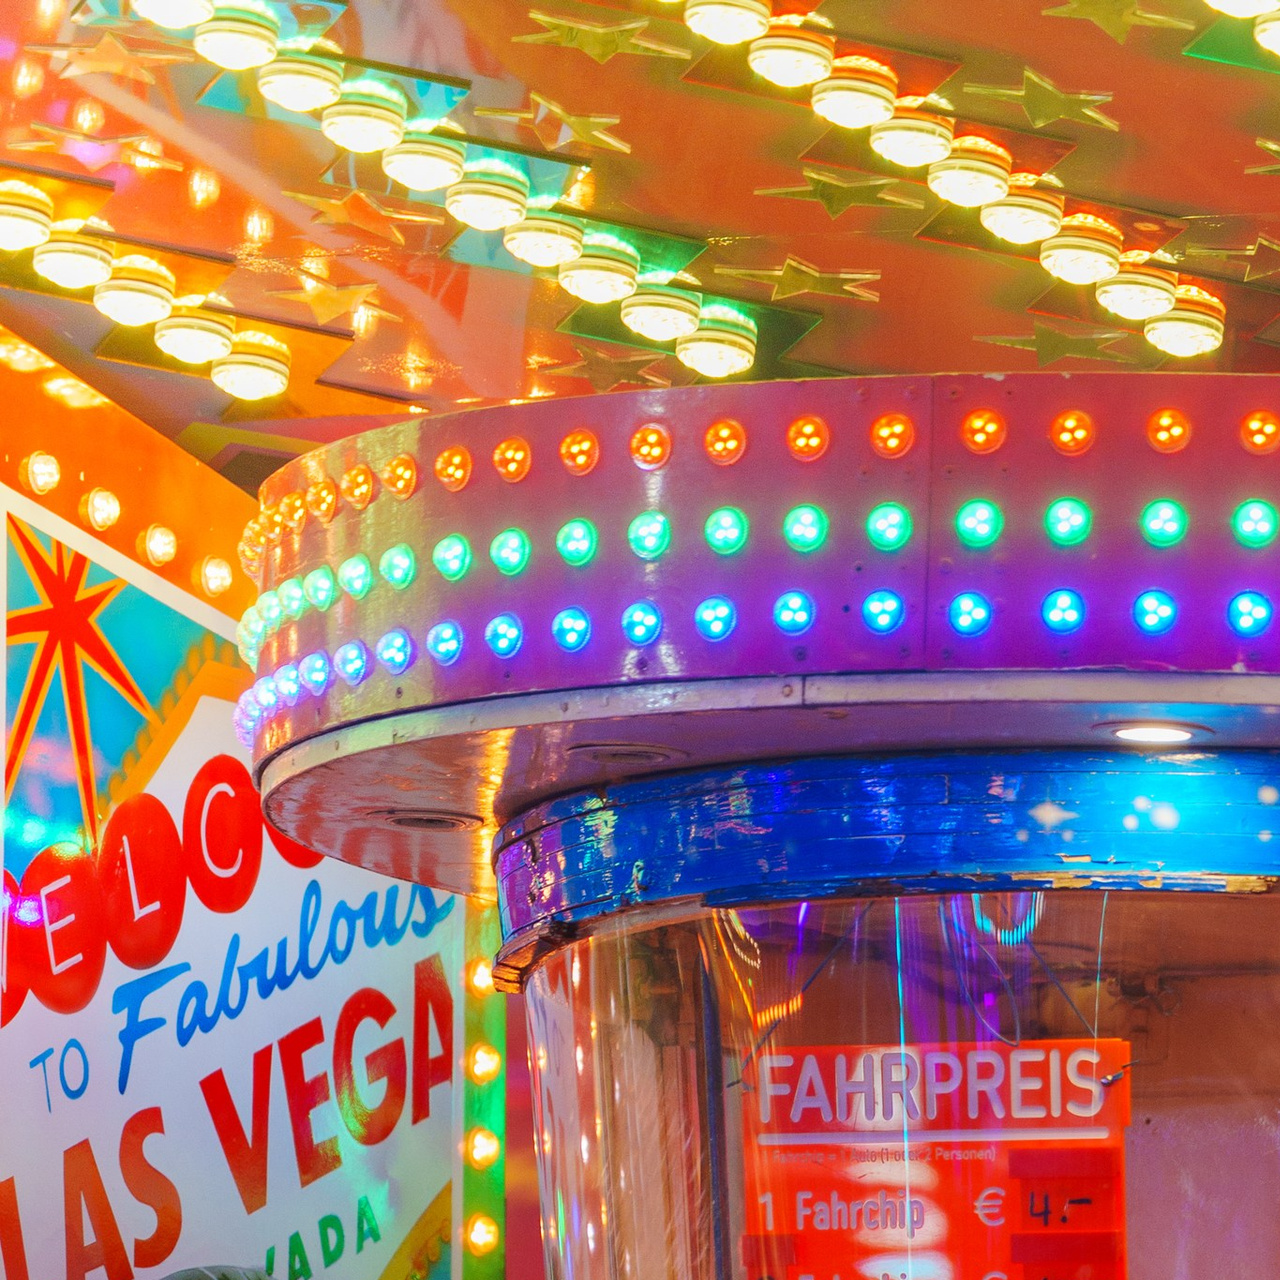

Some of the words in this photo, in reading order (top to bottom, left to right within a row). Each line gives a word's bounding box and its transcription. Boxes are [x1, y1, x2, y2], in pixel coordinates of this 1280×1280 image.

[29, 1038, 90, 1113] TO
[111, 879, 456, 1096] Fabulous
[199, 952, 454, 1216] VEGA
[757, 1048, 1105, 1124] FAHRPREIS
[851, 1148, 878, 1163] Auto
[934, 1147, 996, 1162] Personen)
[759, 1191, 774, 1231] 1
[795, 1190, 926, 1239] Fahrchip
[974, 1187, 1006, 1227] €
